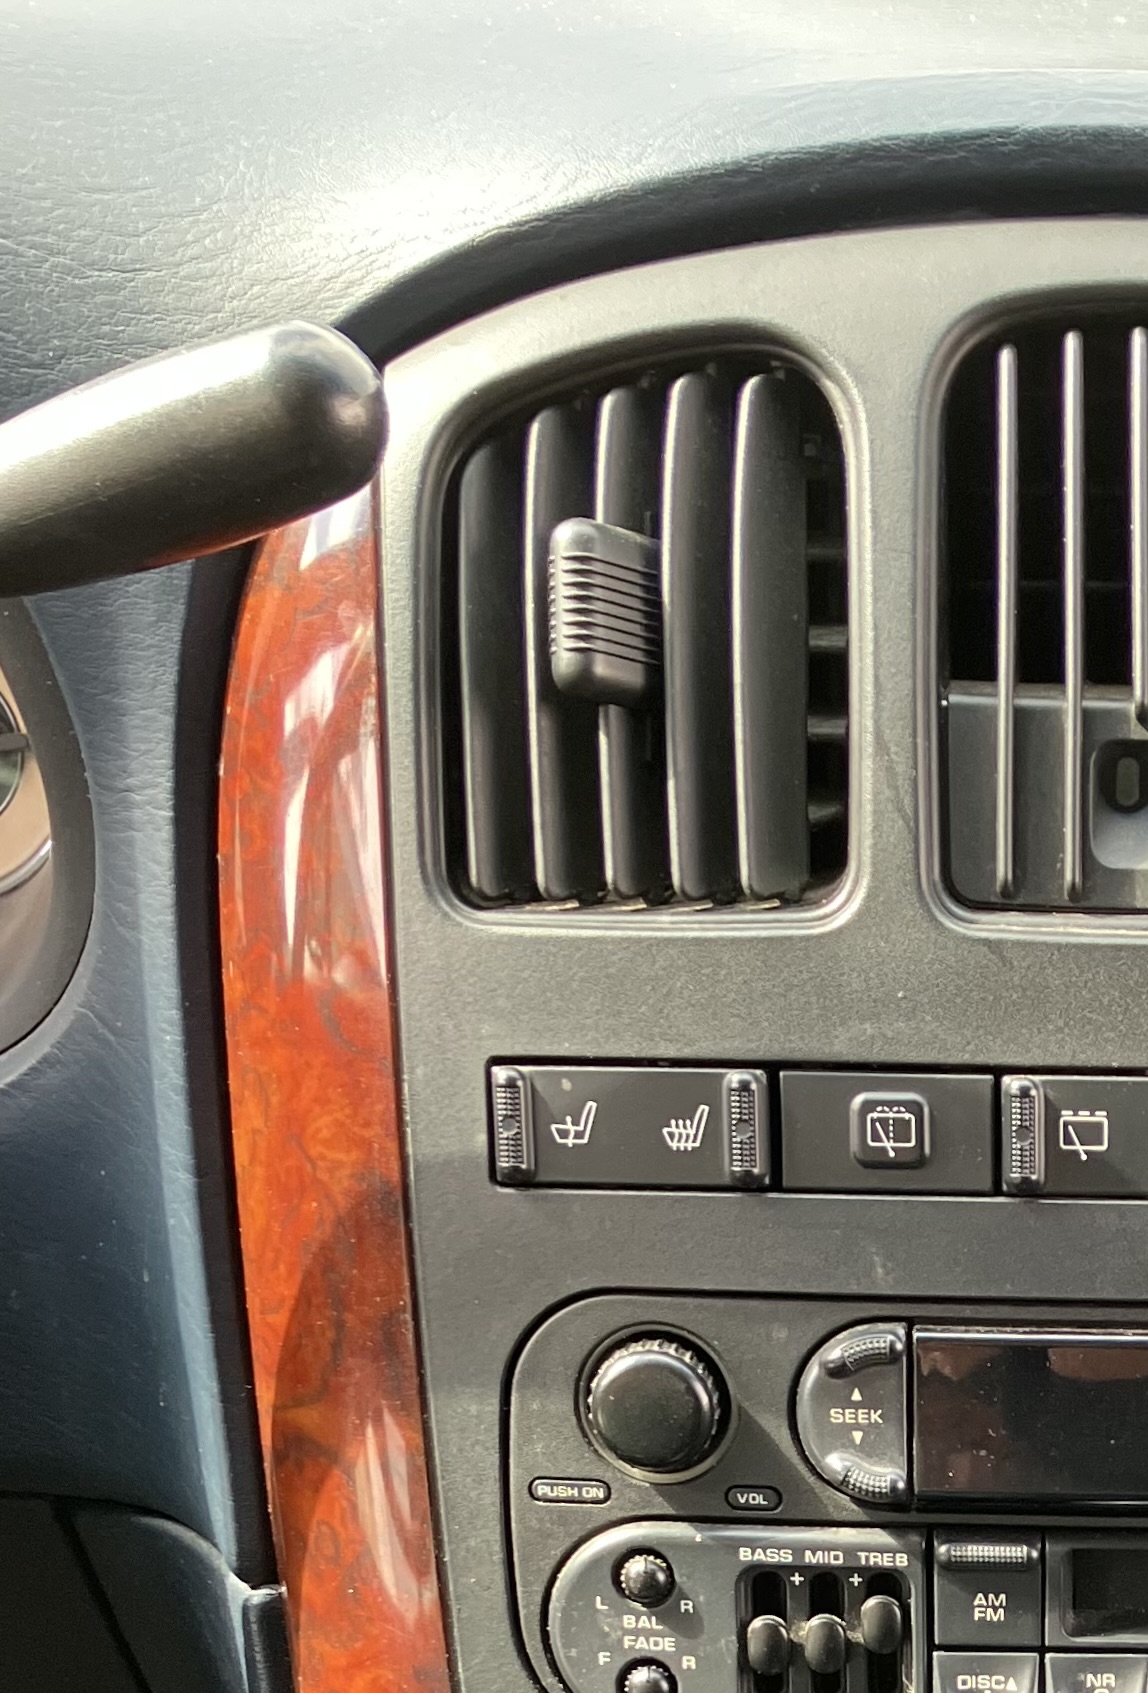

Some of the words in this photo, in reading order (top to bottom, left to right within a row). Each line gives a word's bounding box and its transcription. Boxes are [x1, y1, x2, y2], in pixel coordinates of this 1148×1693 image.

[829, 1407, 883, 1424] SEEK
[537, 1485, 578, 1498] PUSH
[581, 1485, 605, 1499] ON
[736, 1492, 769, 1505] VOL
[739, 1547, 793, 1563] BASS
[804, 1550, 844, 1565] MID
[856, 1551, 909, 1567] TREB
[595, 1595, 608, 1610] L
[679, 1599, 695, 1614] R
[973, 1593, 1007, 1608] AM
[974, 1607, 1005, 1622] FM
[622, 1615, 664, 1631] BAL
[623, 1636, 677, 1652] FADE
[598, 1651, 612, 1666] F
[681, 1655, 697, 1670] R
[956, 1675, 1006, 1690] DISC
[1085, 1673, 1116, 1688] NR
